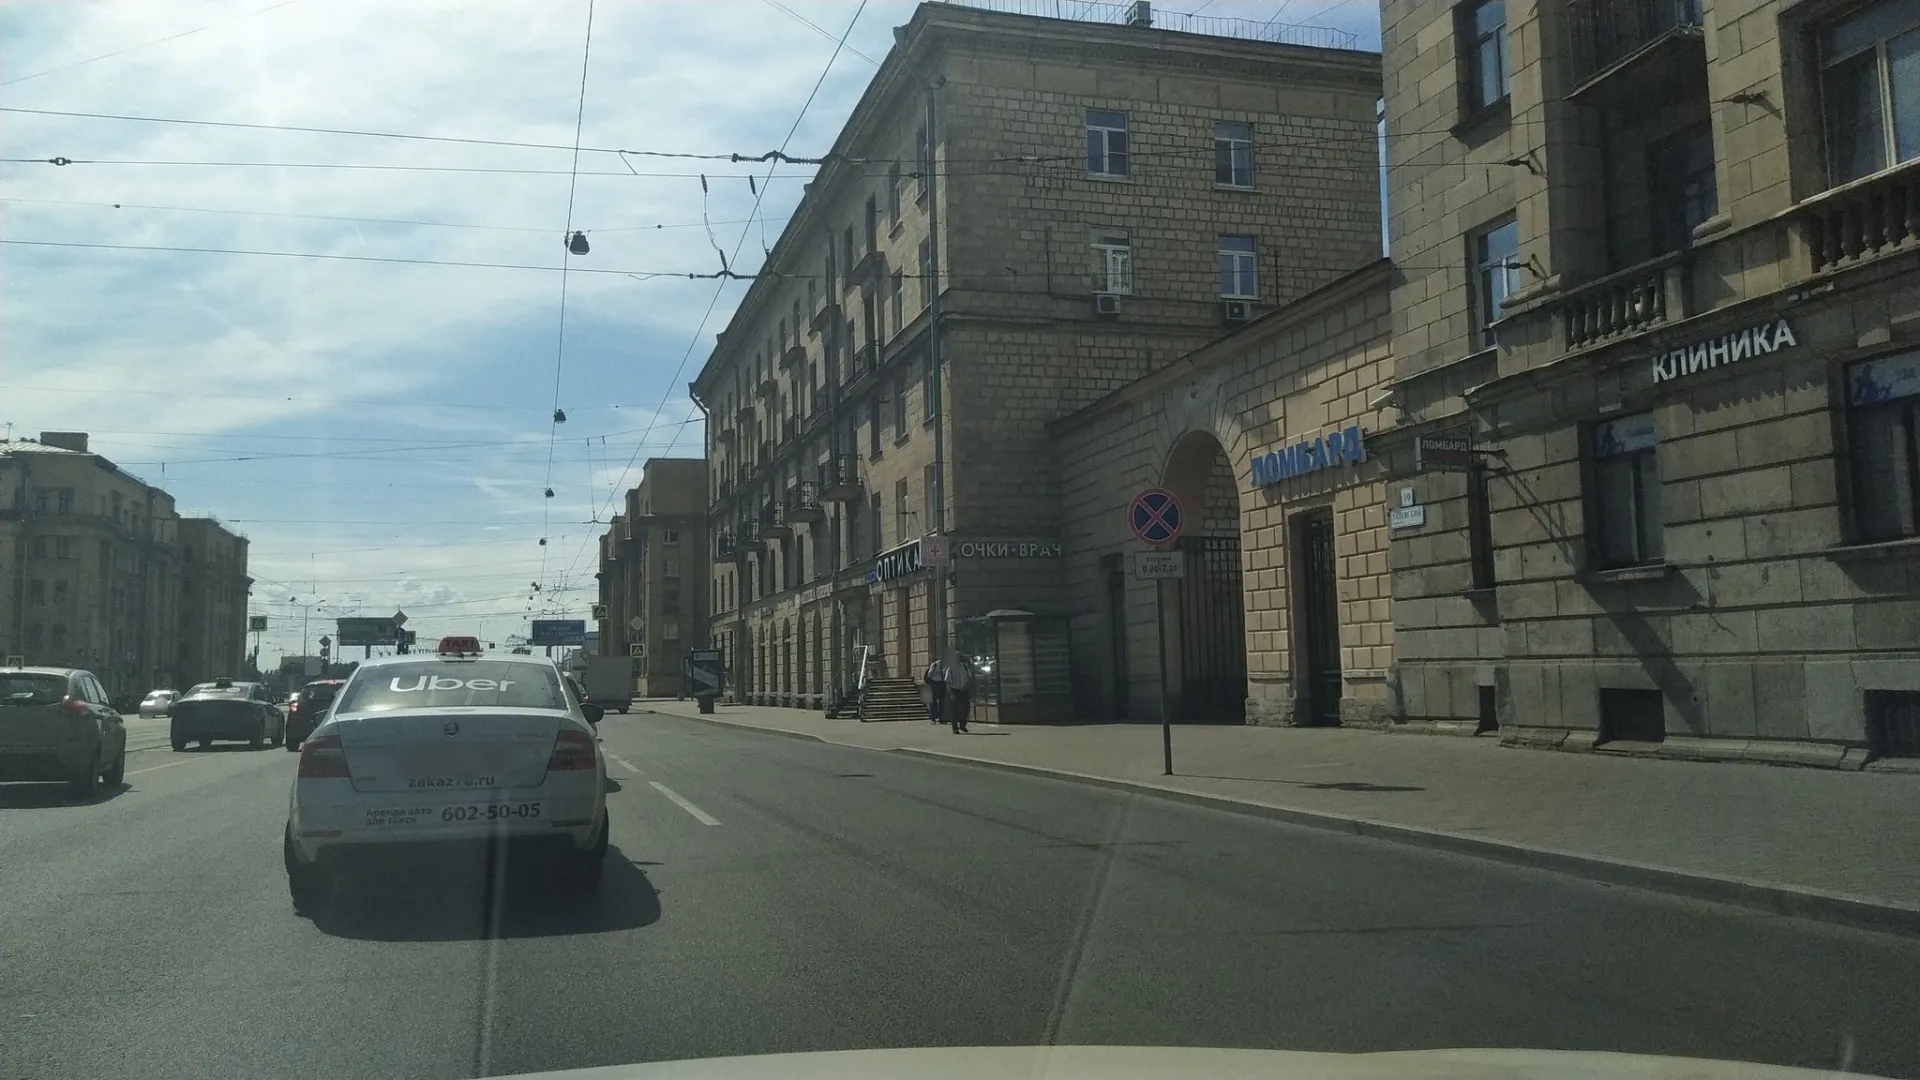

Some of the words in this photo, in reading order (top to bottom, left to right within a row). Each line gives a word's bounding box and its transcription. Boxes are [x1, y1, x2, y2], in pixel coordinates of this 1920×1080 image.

[1652, 319, 1797, 384] КЛИНИКА
[1422, 440, 1468, 452] ЛОМБАРД
[1250, 426, 1365, 487] ЛОМБАРД
[1403, 493, 1411, 502] 10
[961, 543, 1008, 558] ОЧКИ
[1019, 543, 1062, 557] ВРАЧ
[876, 546, 920, 581] ОПТИКА
[389, 675, 516, 692] Uber
[366, 808, 406, 818] Аренда
[408, 808, 433, 816] авто
[442, 803, 541, 821] 602-50-05
